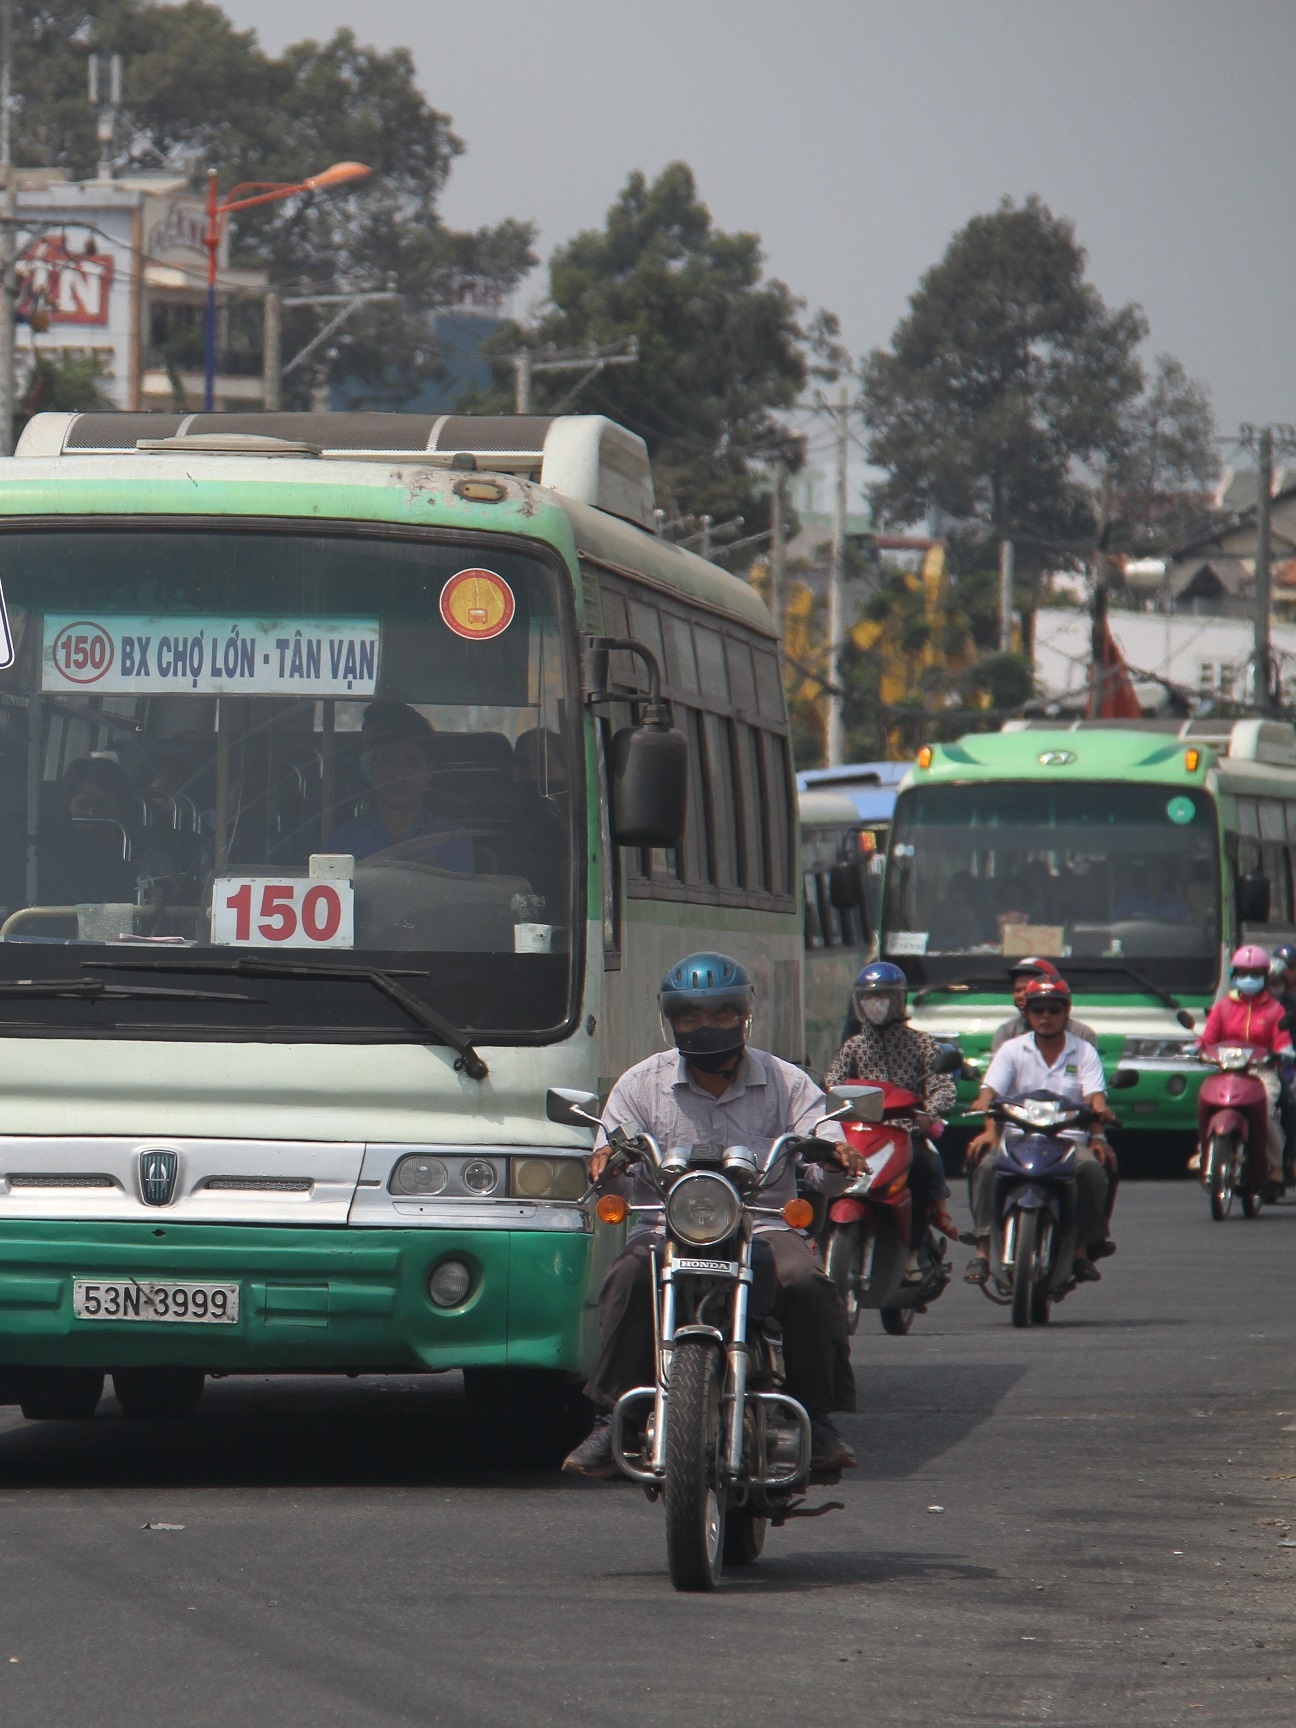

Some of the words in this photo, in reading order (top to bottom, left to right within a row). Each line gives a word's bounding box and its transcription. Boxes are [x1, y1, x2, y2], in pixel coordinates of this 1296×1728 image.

[61, 634, 105, 669] 150
[120, 636, 151, 677] BX
[157, 629, 204, 688] CHỢ
[210, 624, 256, 678] LỚN
[276, 629, 321, 678] TÂN
[329, 639, 376, 690] VẠN
[226, 884, 341, 941] 150
[680, 1261, 729, 1269] HONDA
